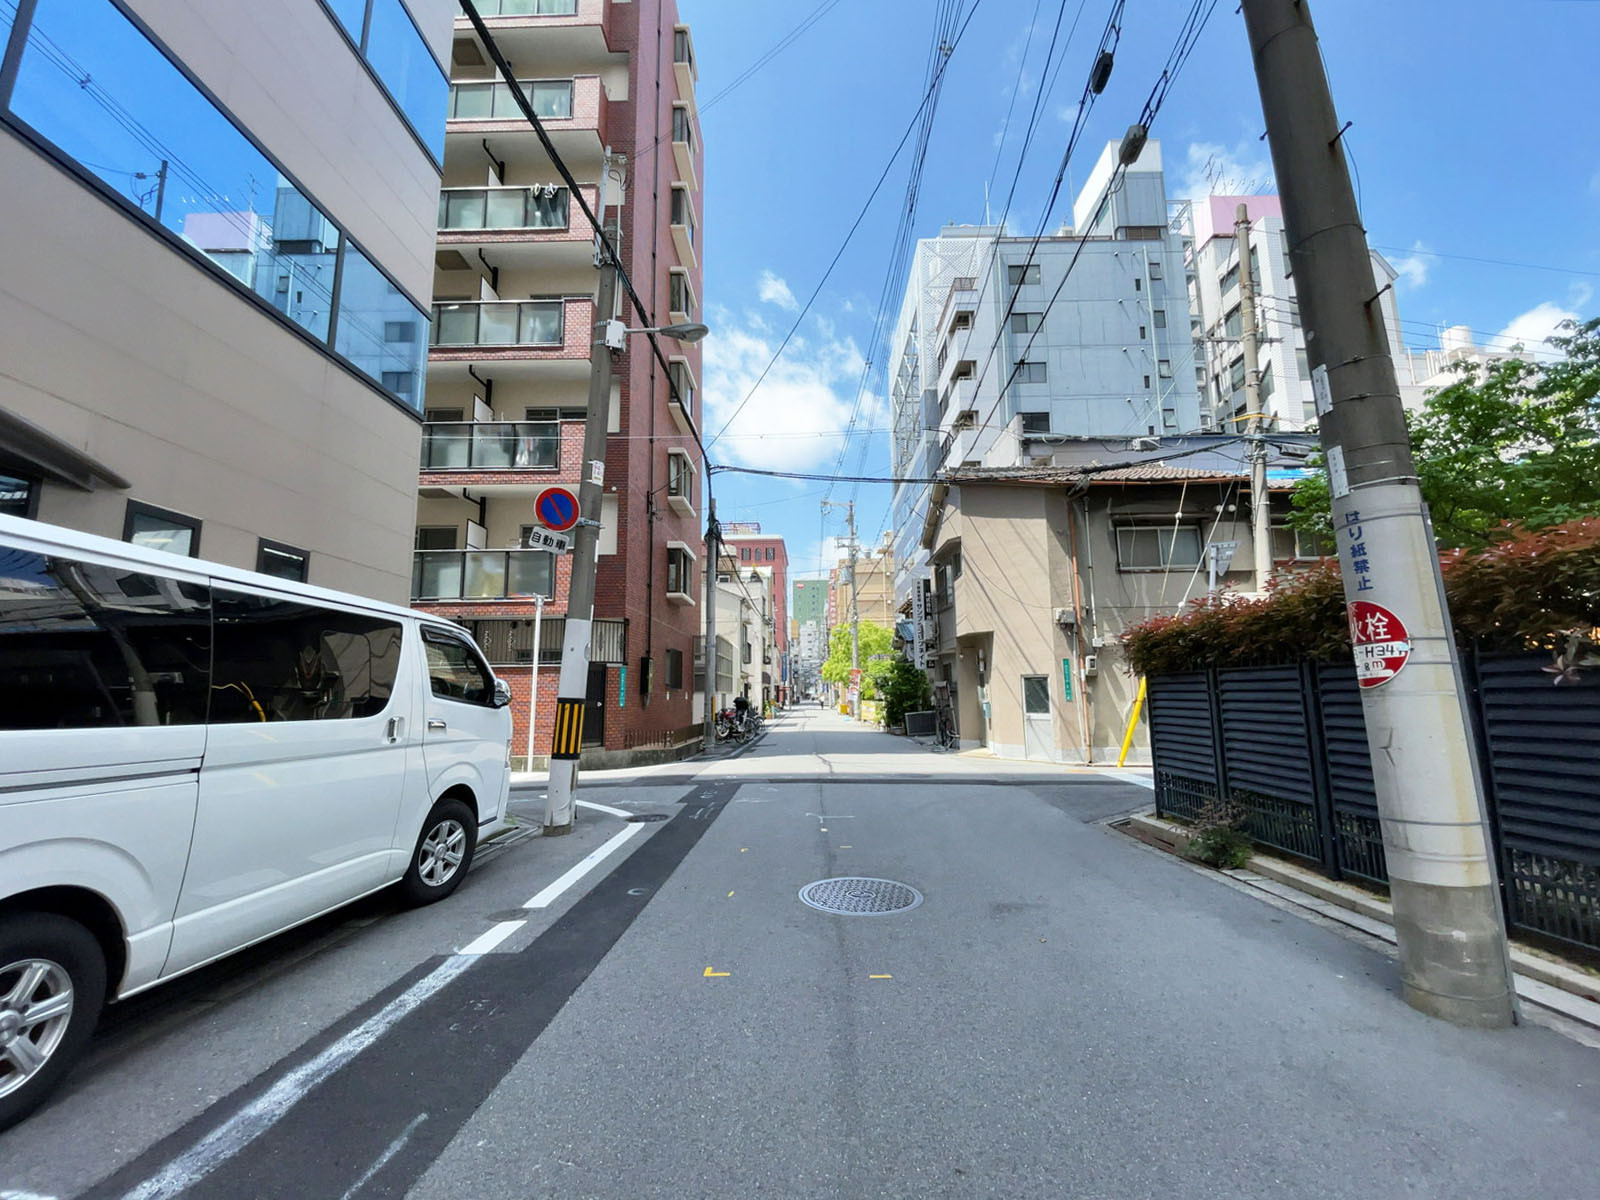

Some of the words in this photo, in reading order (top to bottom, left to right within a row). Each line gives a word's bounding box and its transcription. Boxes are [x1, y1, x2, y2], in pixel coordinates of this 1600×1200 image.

[531, 531, 567, 551] 自動車
[1345, 510, 1374, 592] はり紙禁止
